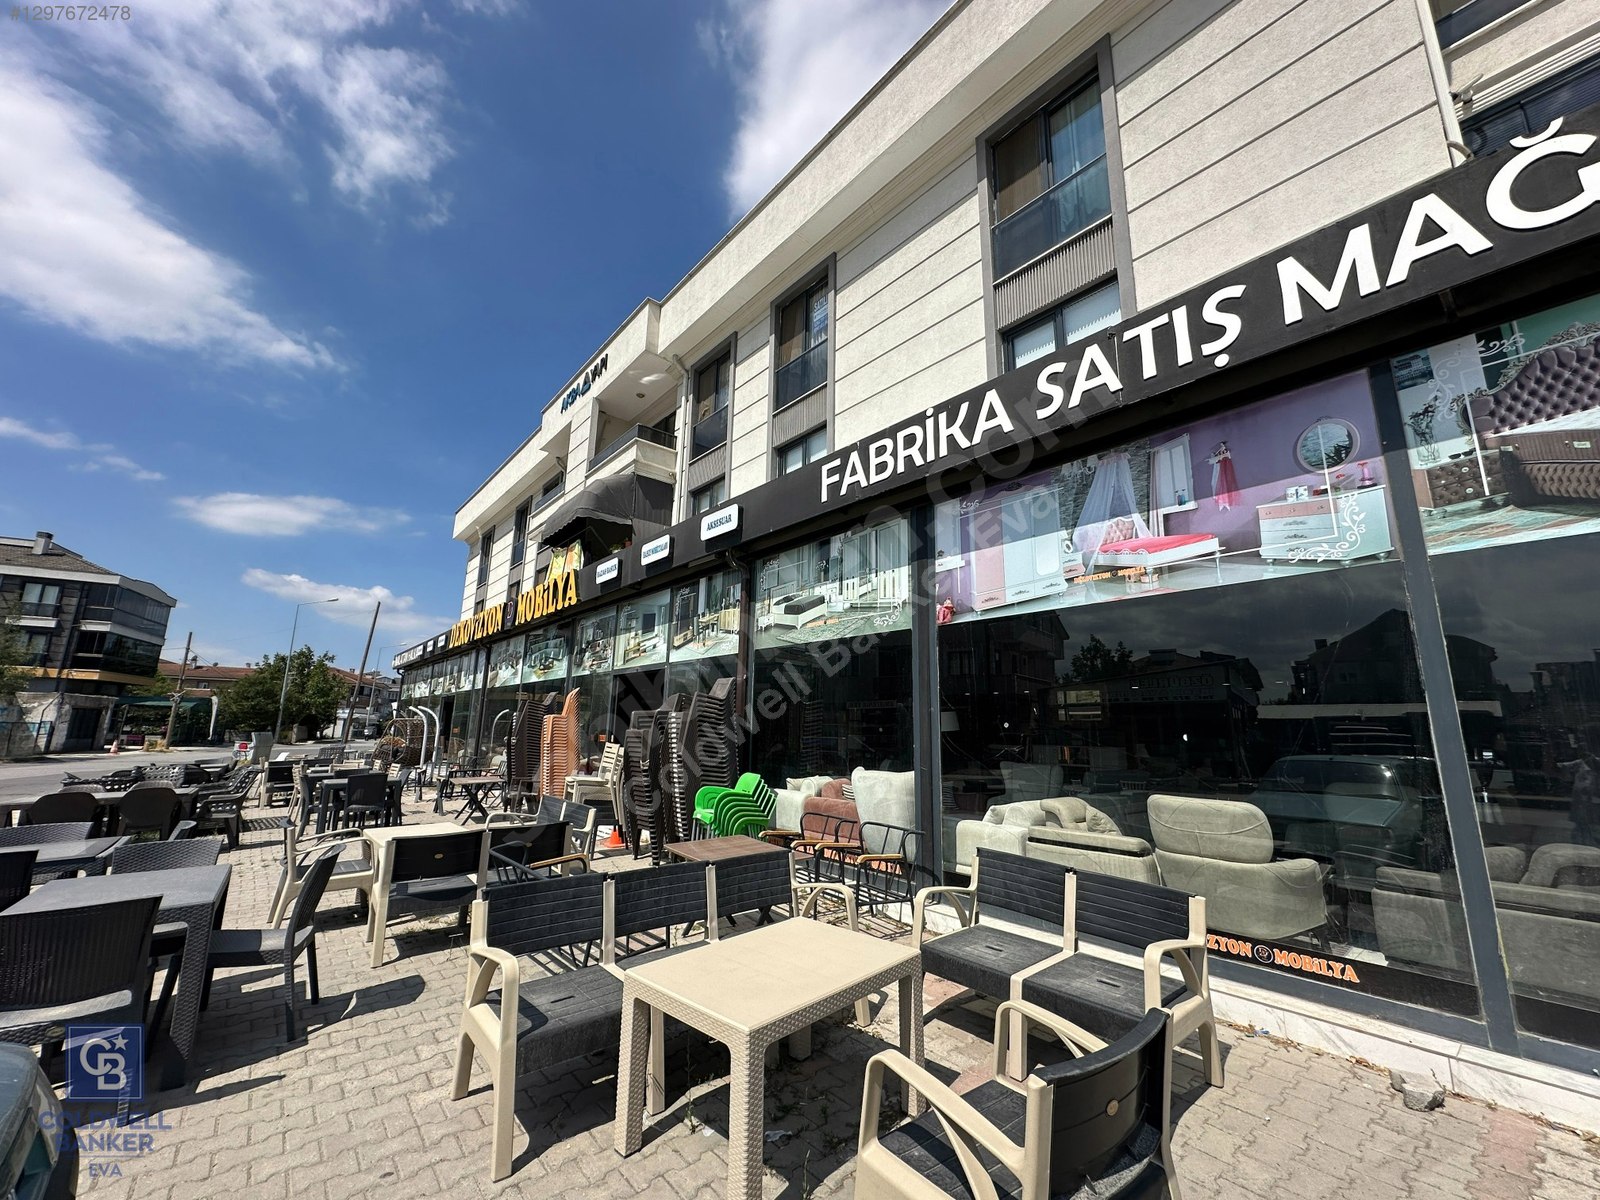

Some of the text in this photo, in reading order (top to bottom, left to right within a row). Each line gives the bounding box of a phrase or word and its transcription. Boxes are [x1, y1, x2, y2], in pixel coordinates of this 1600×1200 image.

[821, 117, 1600, 503] FABRİKA SATIŞ MAĞ
[1206, 934, 1253, 958] ZYON
